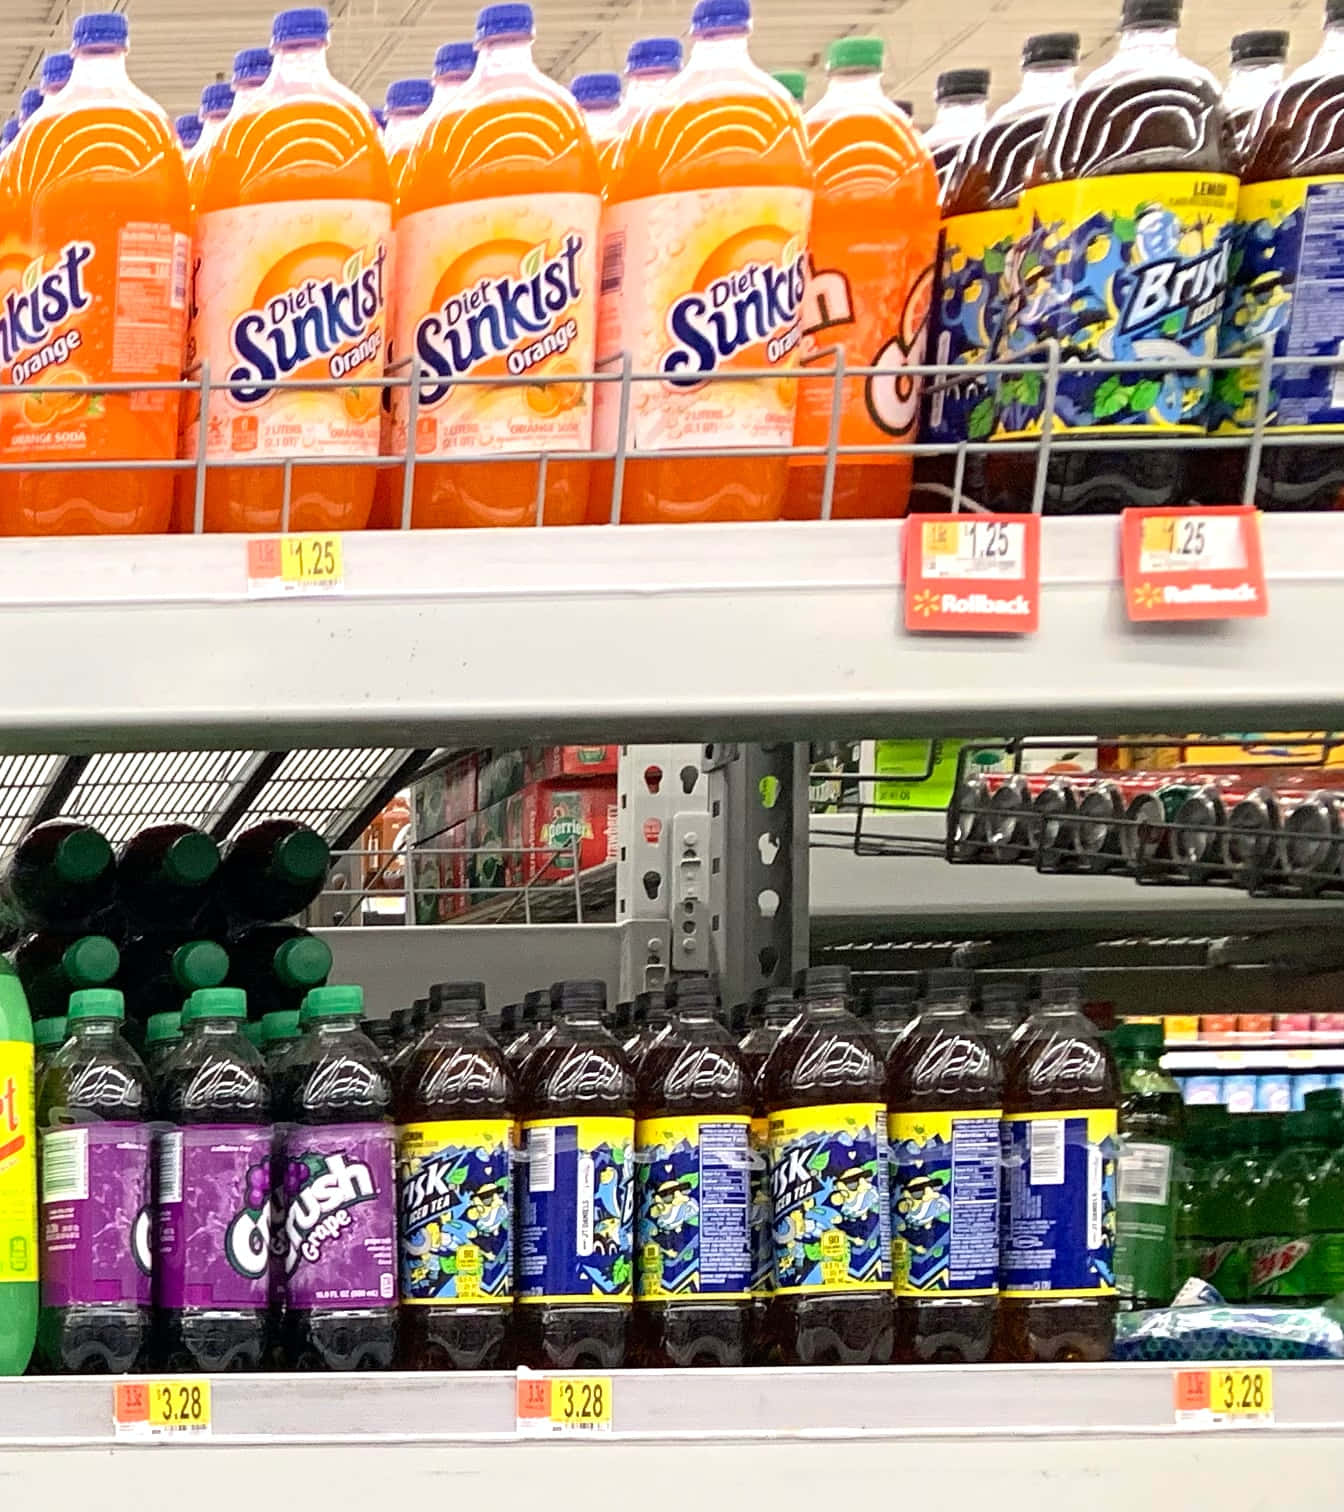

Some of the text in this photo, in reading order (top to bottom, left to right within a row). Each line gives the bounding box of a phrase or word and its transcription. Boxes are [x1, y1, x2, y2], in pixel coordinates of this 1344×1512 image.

[269, 280, 318, 321] Diet
[444, 280, 491, 322] Diet
[711, 269, 758, 307] Diet
[228, 243, 387, 407] Sunkist
[416, 232, 583, 407] Sunkist
[662, 246, 808, 391] Sunkis
[12, 329, 80, 382] Orange
[329, 332, 382, 380] Orange
[508, 320, 578, 375] Orange
[942, 595, 1029, 615] Rollback
[1163, 585, 1257, 602] Rollback
[301, 1210, 352, 1262] Grape
